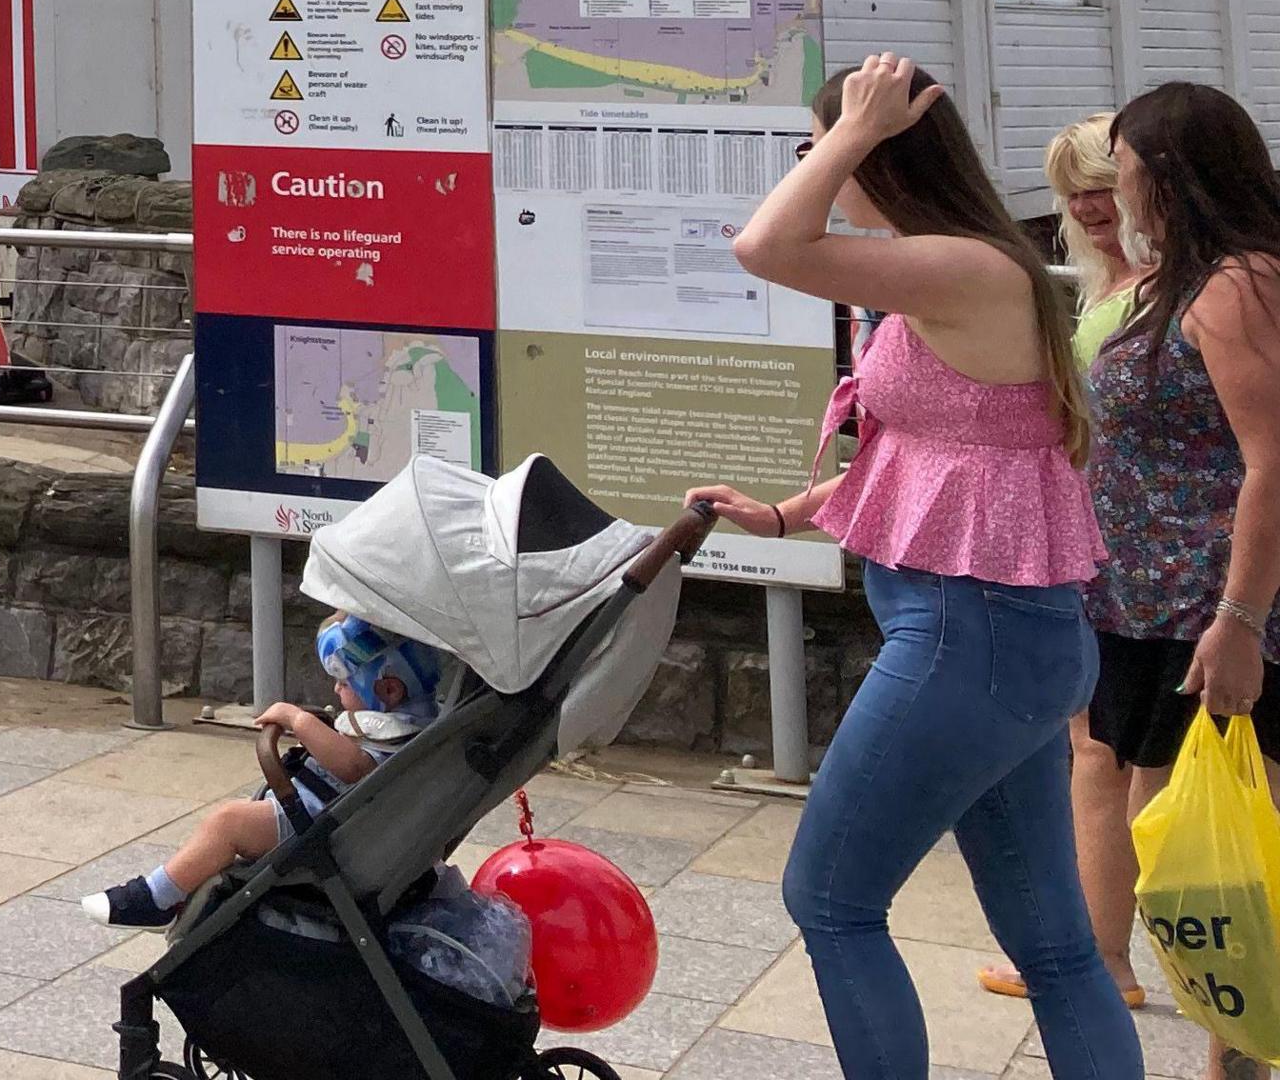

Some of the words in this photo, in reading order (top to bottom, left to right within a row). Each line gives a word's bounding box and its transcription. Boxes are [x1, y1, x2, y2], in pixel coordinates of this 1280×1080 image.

[433, 4, 463, 13] moving
[429, 34, 474, 42] windsports
[415, 43, 436, 51] kites,
[439, 44, 467, 52] surfing
[415, 53, 464, 62] windsurfing
[308, 81, 342, 89] personal
[309, 114, 330, 122] Clean
[340, 116, 351, 124] up
[580, 109, 599, 119] Tide
[601, 109, 649, 120] timetables
[450, 117, 463, 126] up!
[330, 124, 358, 132] penalty)
[417, 126, 437, 134] (fixed
[439, 127, 468, 135] penalty)
[272, 171, 384, 199] Caution
[272, 227, 307, 239] There
[311, 228, 320, 240] is
[324, 231, 340, 240] no
[344, 230, 401, 245] lifeguard
[272, 244, 314, 256] service
[319, 247, 380, 262] operating
[290, 336, 336, 345] Knightstone
[585, 348, 616, 360] Local
[620, 350, 713, 366] environmental
[717, 357, 795, 371] information
[301, 508, 332, 522] North
[712, 563, 738, 572] 01934
